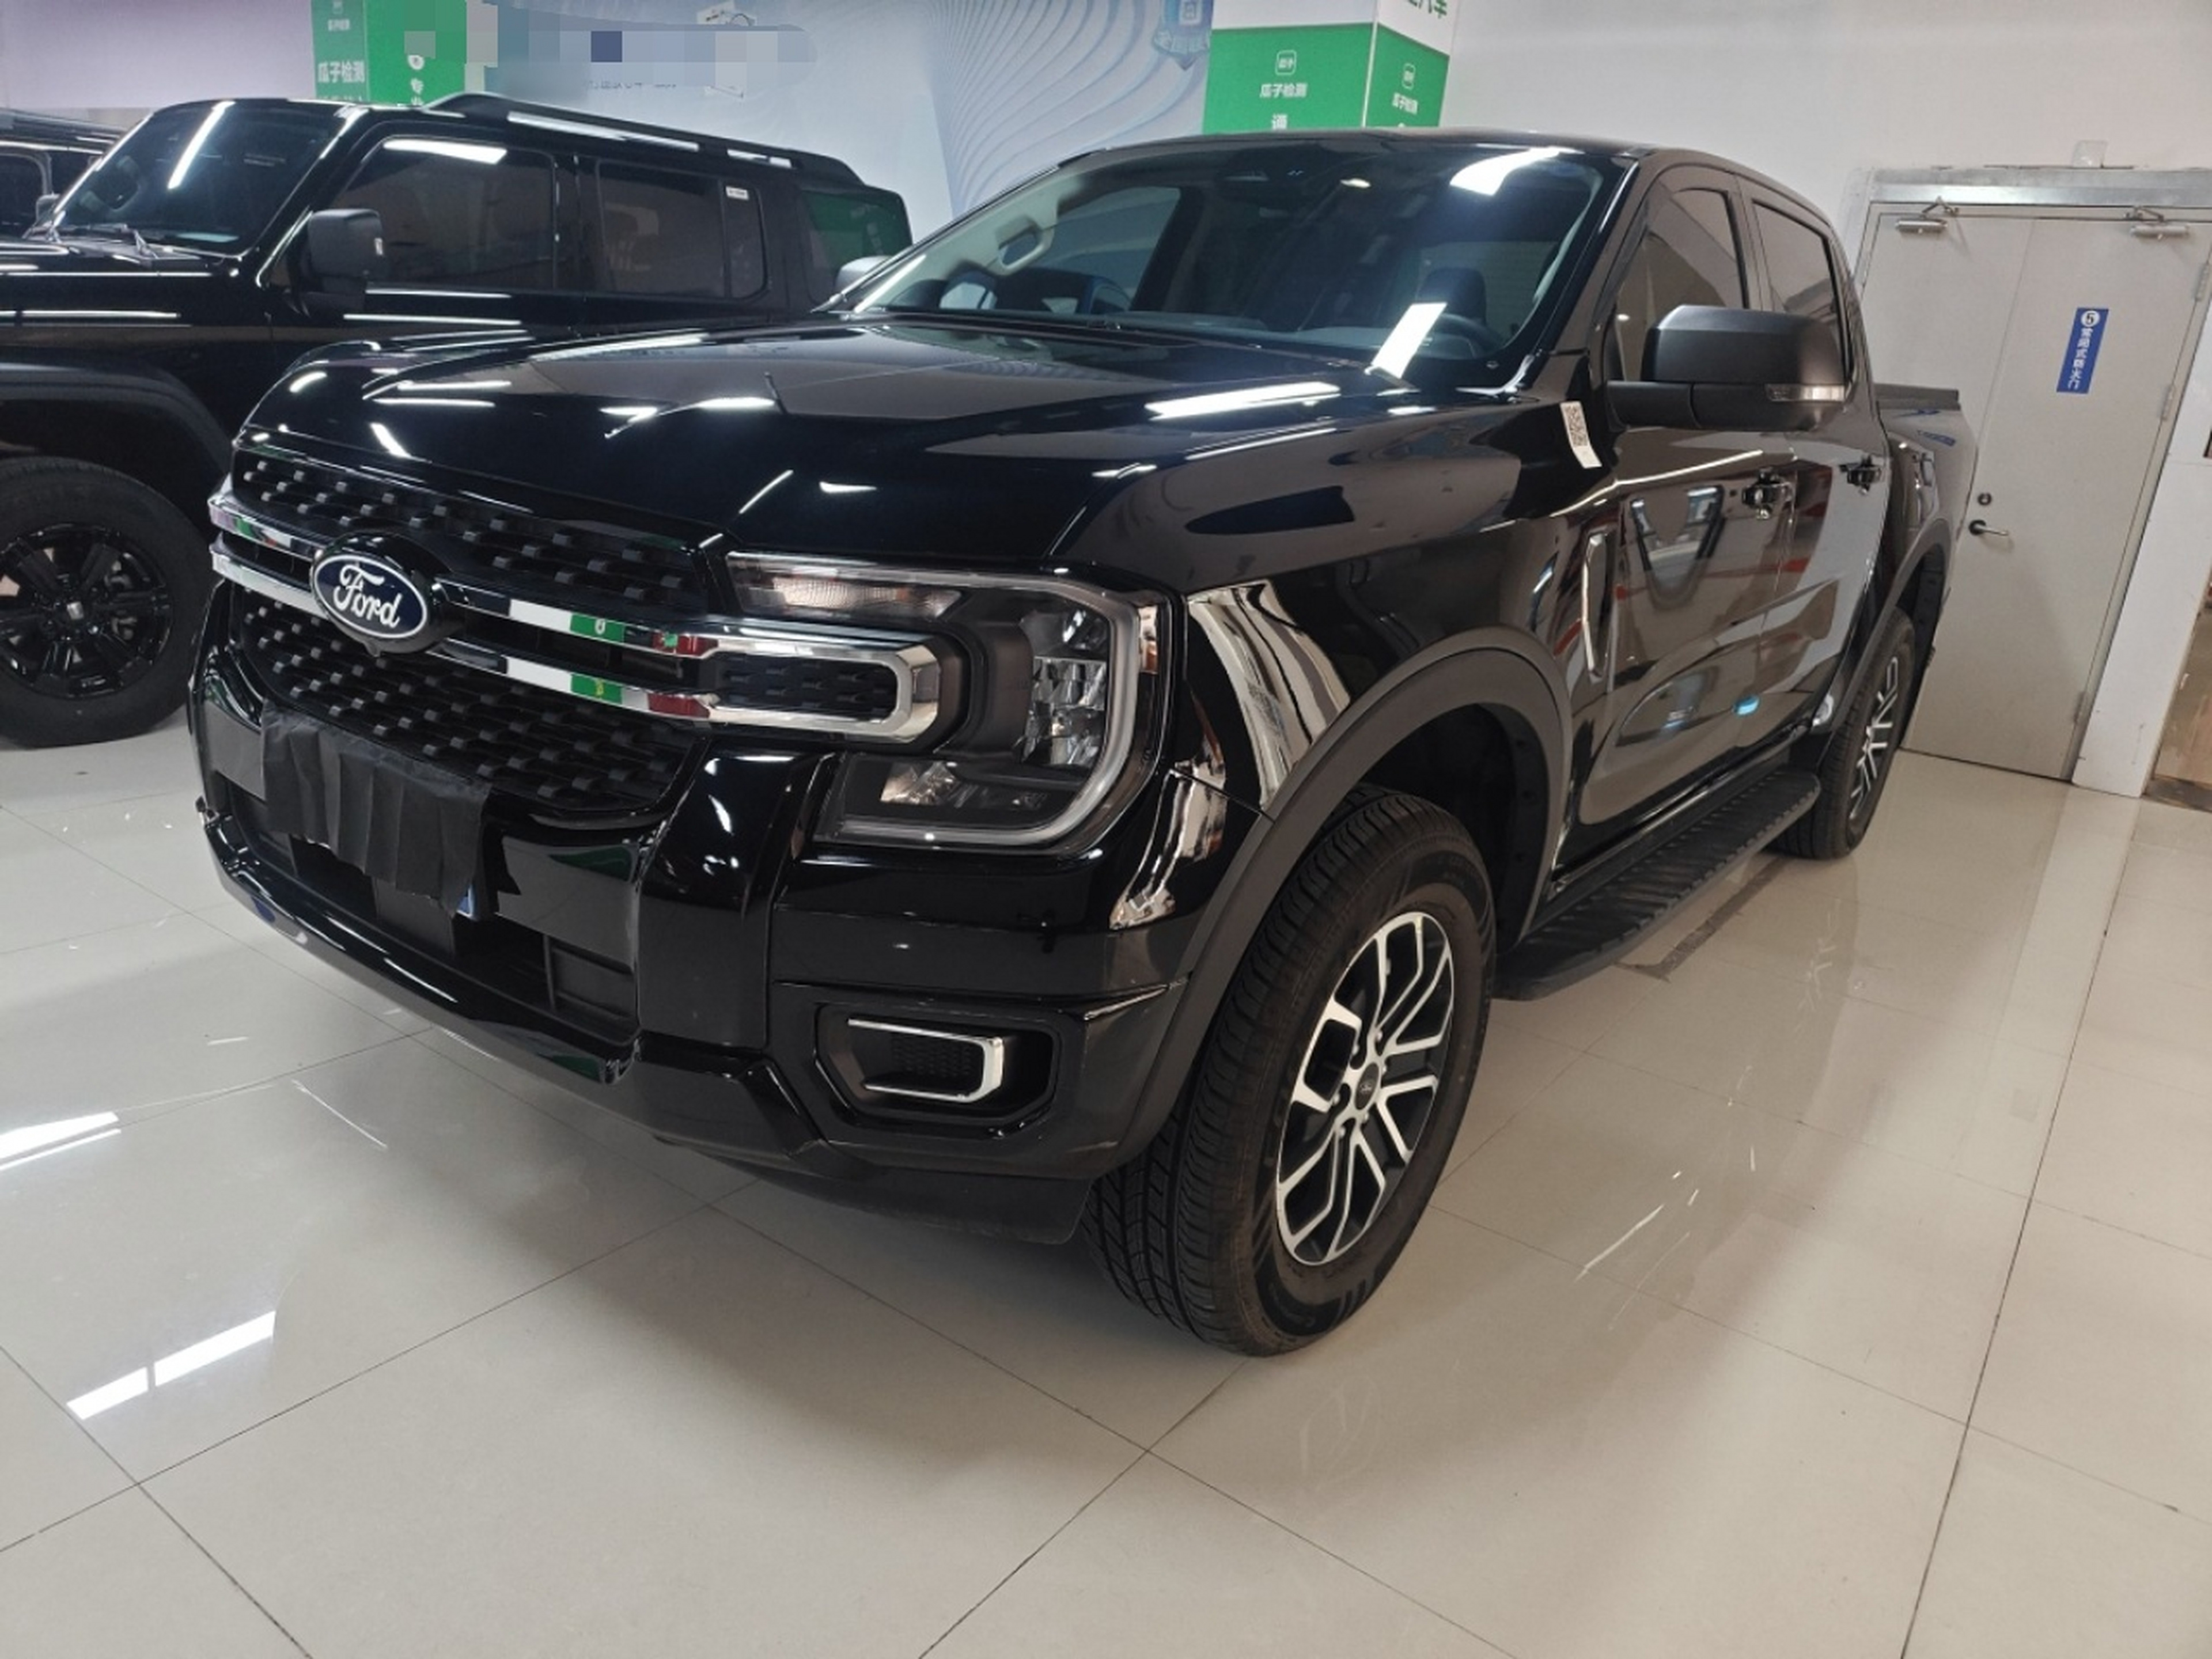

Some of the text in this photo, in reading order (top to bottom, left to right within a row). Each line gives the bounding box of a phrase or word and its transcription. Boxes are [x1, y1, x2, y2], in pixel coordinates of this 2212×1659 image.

[318, 60, 365, 83] 瓜子检测
[1259, 83, 1308, 98] 瓜子检测
[2085, 312, 2096, 325] 5
[333, 564, 402, 628] Ford
